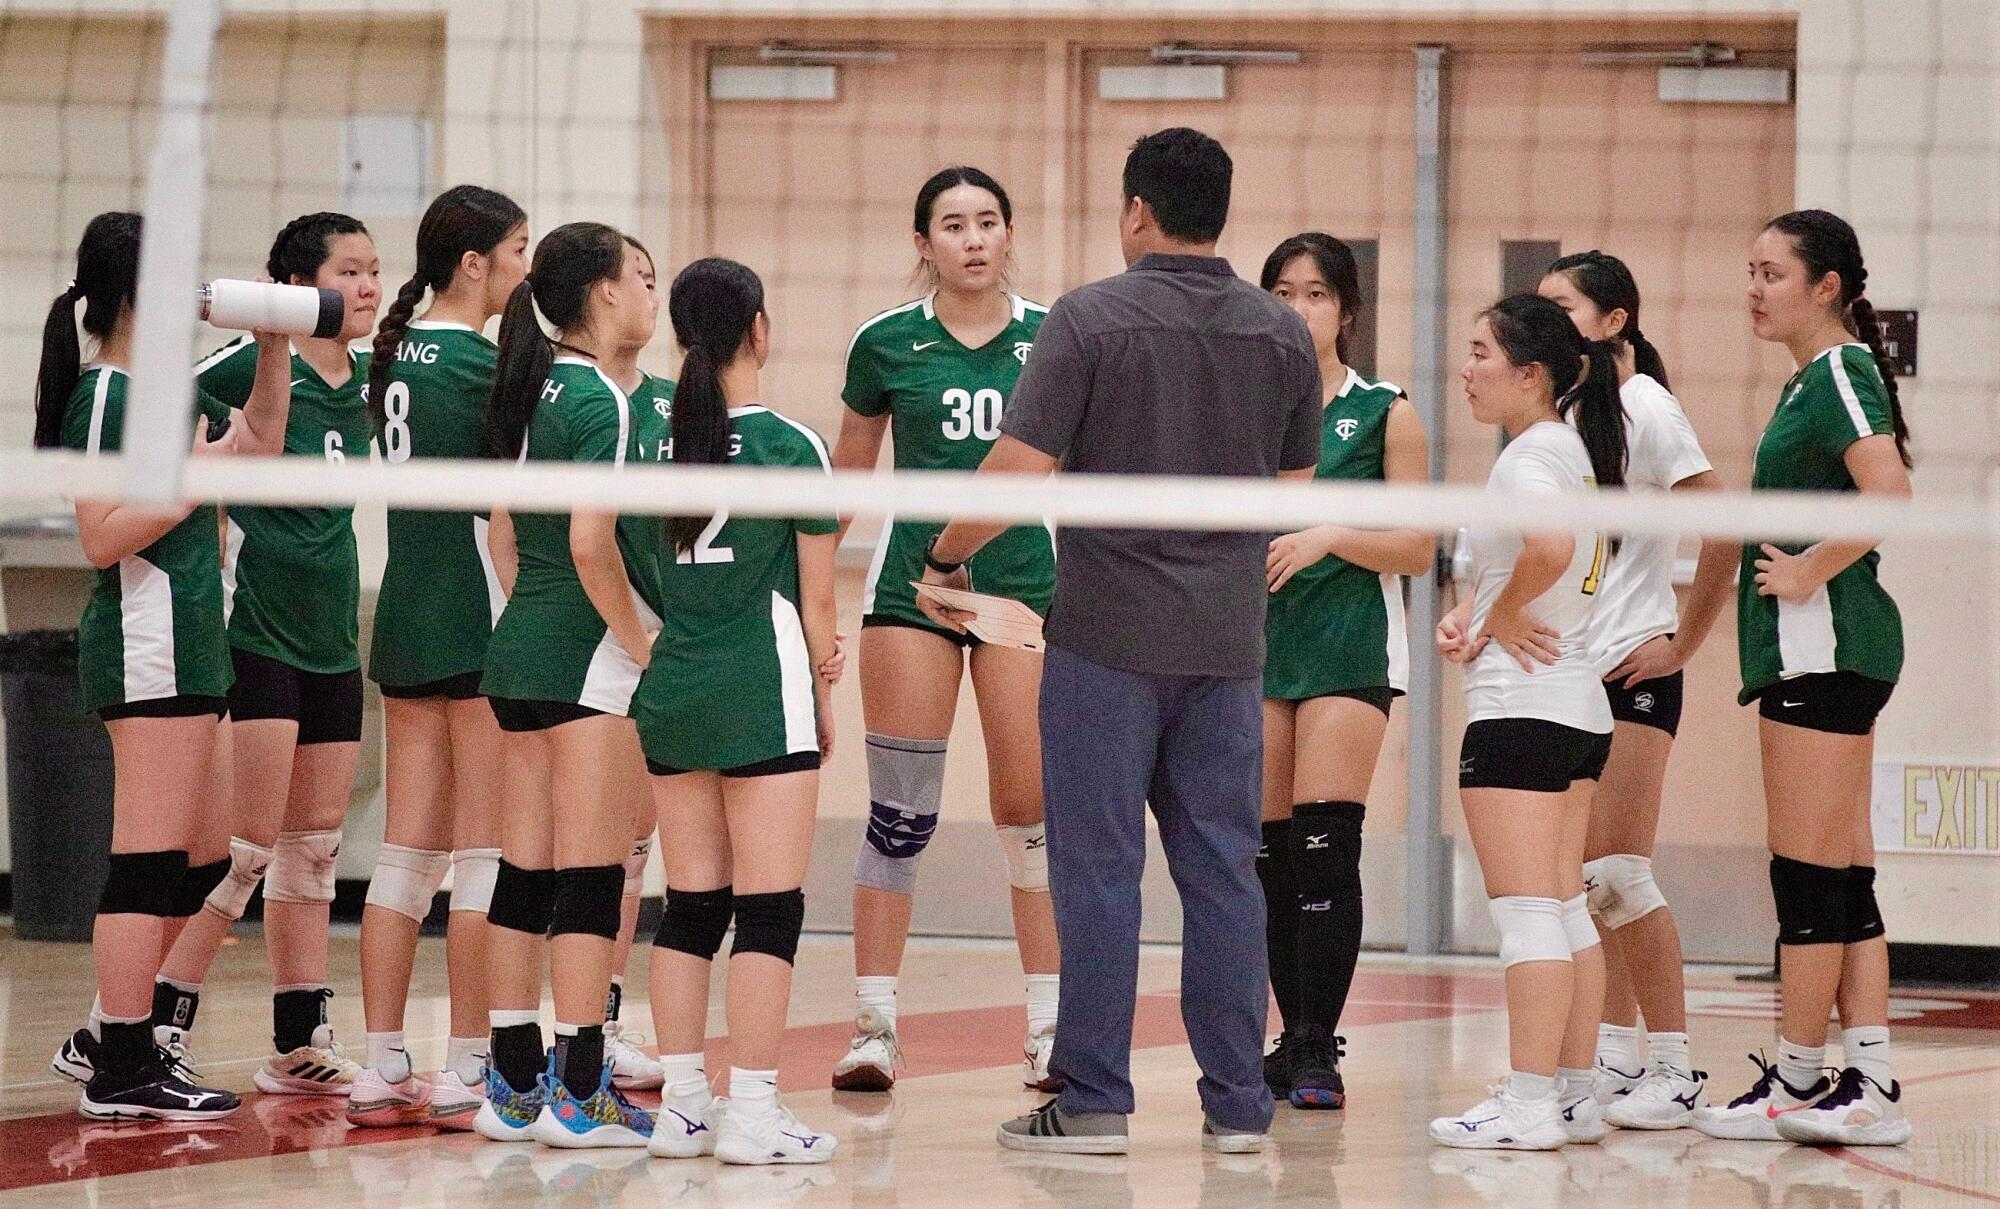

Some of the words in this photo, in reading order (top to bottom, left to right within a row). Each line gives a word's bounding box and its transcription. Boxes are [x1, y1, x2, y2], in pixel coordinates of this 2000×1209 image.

[384, 380, 412, 463] 8
[941, 388, 1003, 441] 30
[1904, 766, 2000, 850] EXIT
